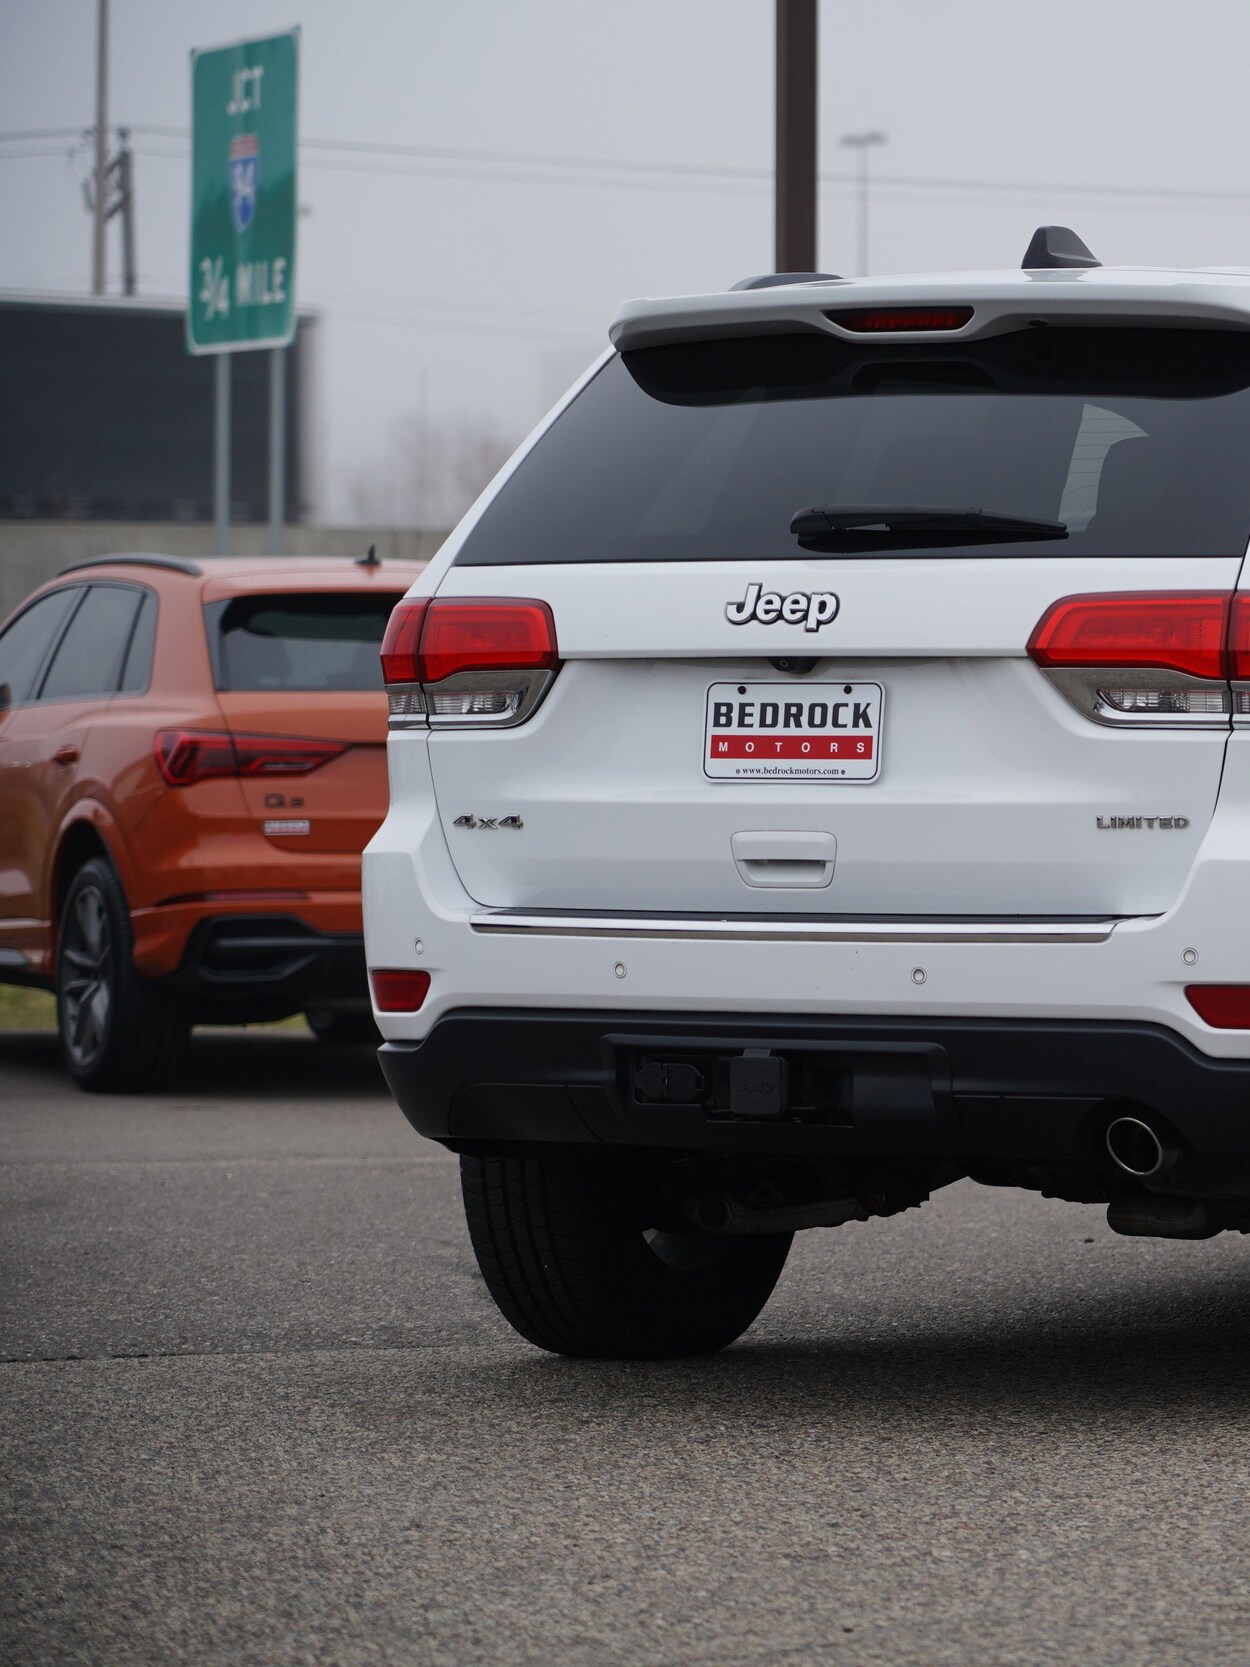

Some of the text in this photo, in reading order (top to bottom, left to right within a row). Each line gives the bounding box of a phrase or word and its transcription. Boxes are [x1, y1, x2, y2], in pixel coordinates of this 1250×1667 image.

[226, 65, 264, 116] JCT
[235, 256, 286, 307] MILE
[725, 582, 841, 633] Jeep
[712, 702, 873, 729] BEDROCK
[718, 741, 865, 753] MOTORS
[742, 766, 840, 776] www.bedrockmotors.com
[452, 812, 524, 830] 4x4
[1096, 814, 1192, 831] LIMITED
